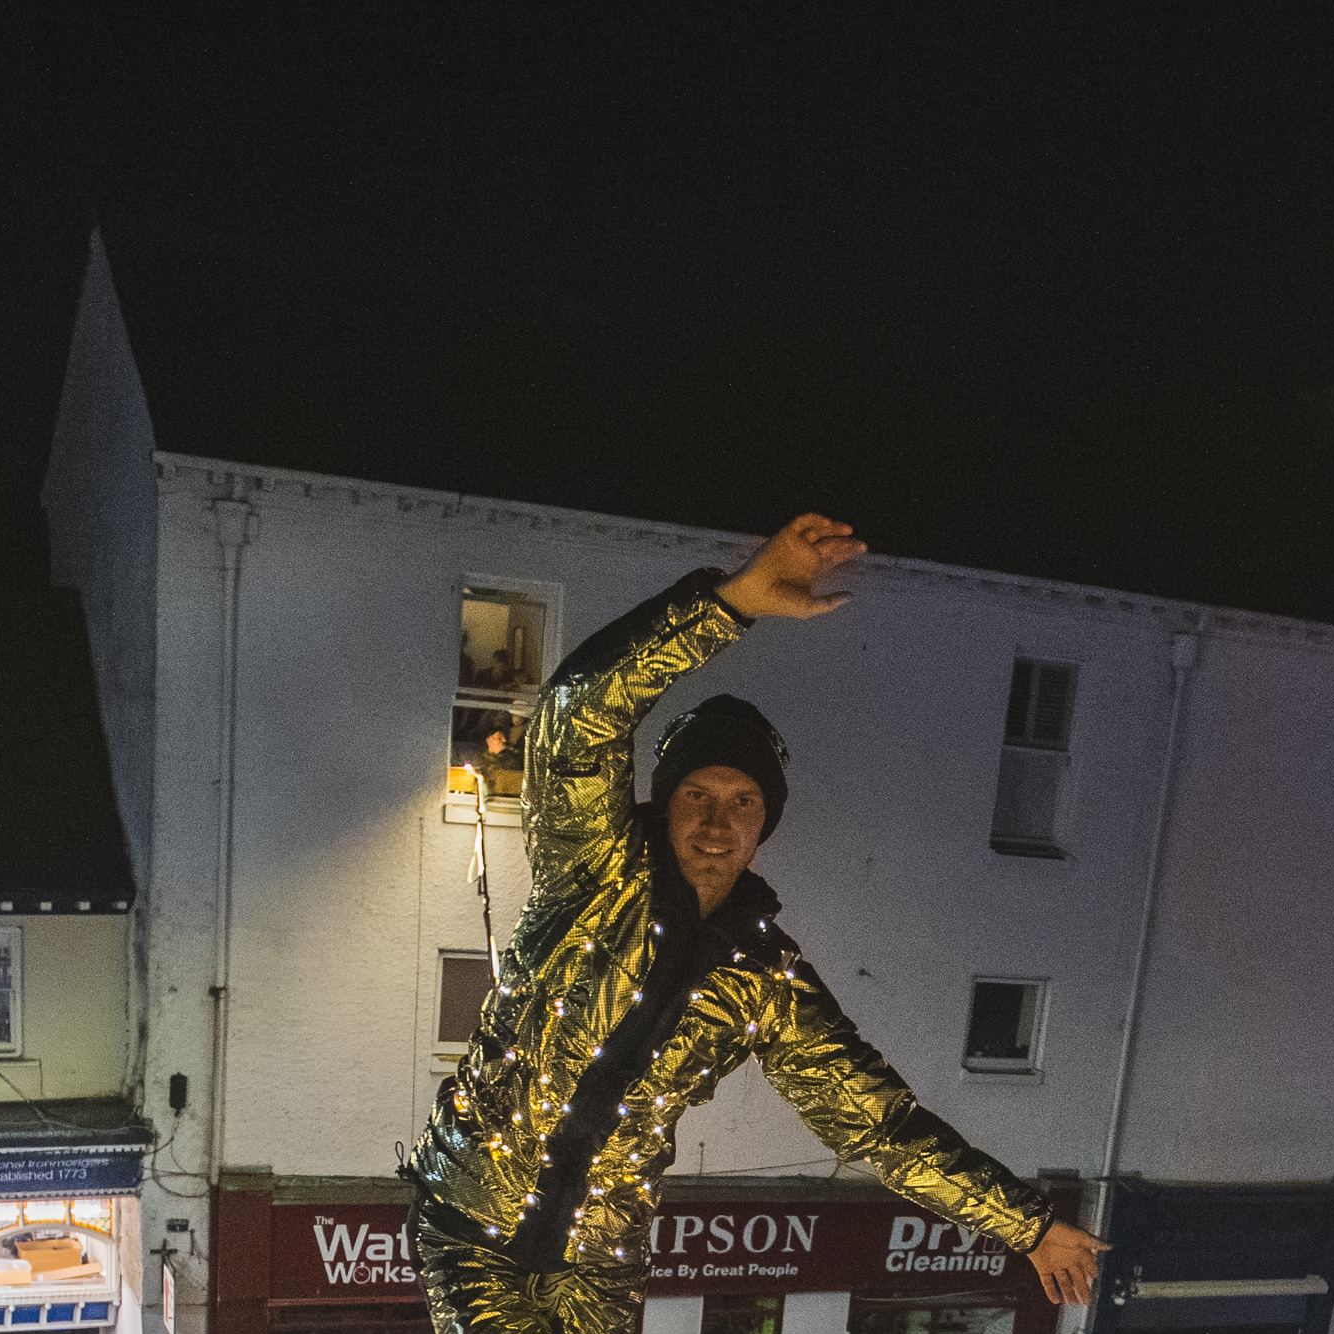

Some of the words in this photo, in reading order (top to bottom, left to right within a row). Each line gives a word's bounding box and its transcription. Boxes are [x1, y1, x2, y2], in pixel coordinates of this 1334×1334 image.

[58, 1168, 87, 1180] 1773
[315, 1215, 334, 1225] The
[888, 1216, 979, 1253] Dry
[324, 1261, 417, 1284] Works
[677, 1264, 698, 1279] By
[702, 1263, 744, 1277] Great
[748, 1263, 799, 1278] People
[886, 1250, 1007, 1276] Cleaning
